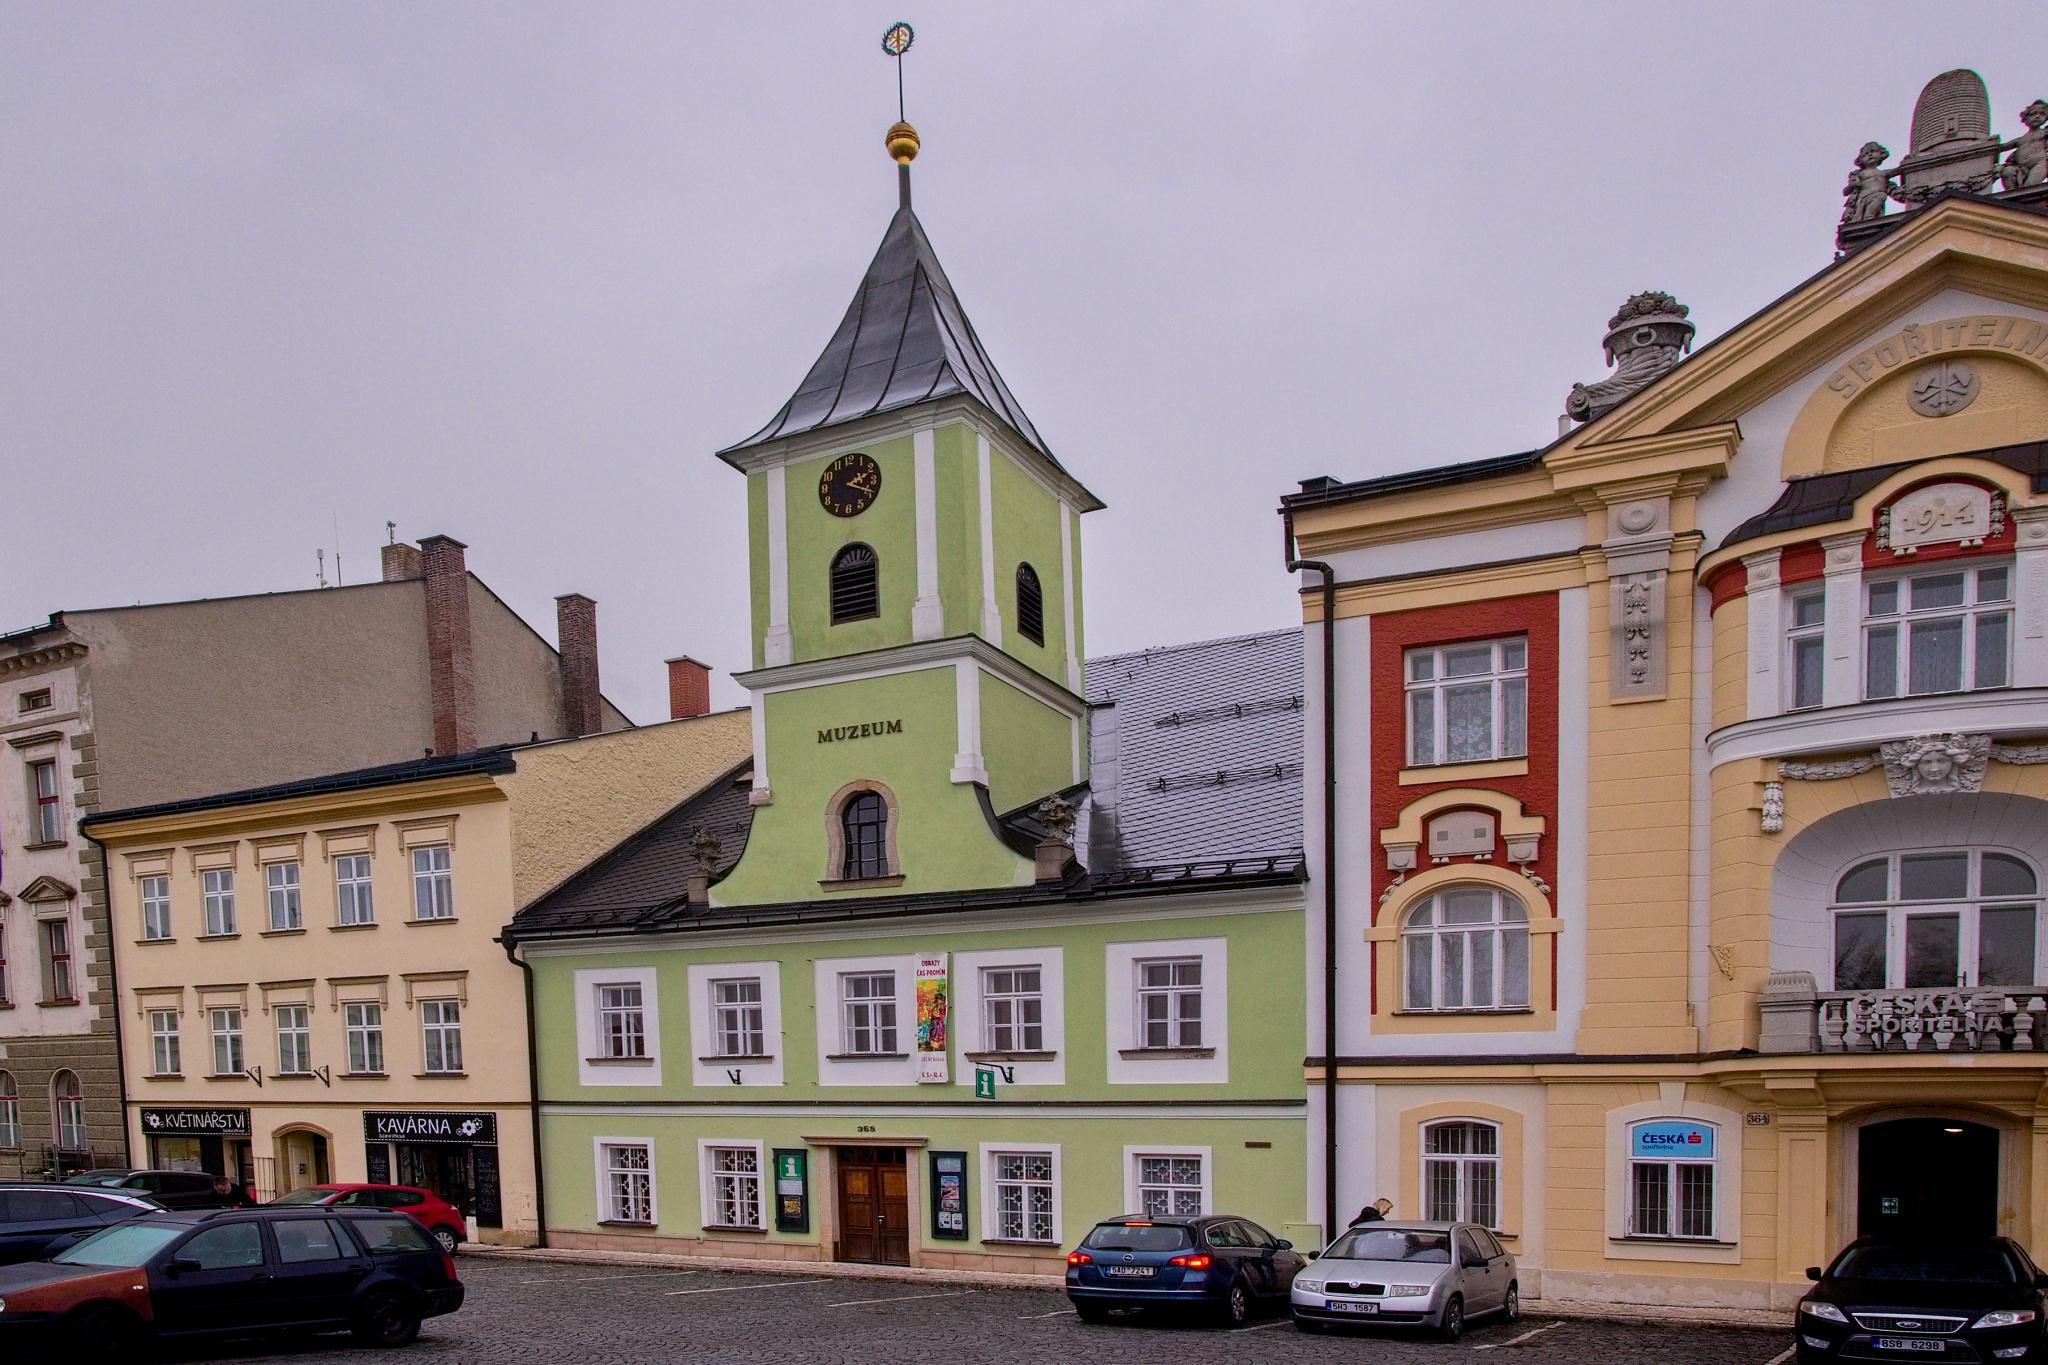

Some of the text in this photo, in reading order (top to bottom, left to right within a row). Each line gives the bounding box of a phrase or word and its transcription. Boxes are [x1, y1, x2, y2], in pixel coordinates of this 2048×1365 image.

[1828, 318, 2048, 399] SPOŘITELN
[834, 460, 841, 470] 11
[845, 455, 855, 466] 12
[859, 456, 863, 466] 1
[867, 463, 874, 473] 2
[823, 471, 833, 482] 10
[870, 474, 877, 485] 3
[821, 484, 828, 494] 9
[825, 496, 831, 505] 8
[857, 499, 864, 509] 5
[834, 503, 840, 513] 7
[845, 504, 852, 514] 6
[1903, 500, 1975, 535] 1914
[817, 719, 903, 744] MUZEUM
[1852, 991, 1967, 1015] ČESKÁ
[165, 1111, 245, 1129] KVĚTINÁŘSTVÍ
[1748, 1113, 1769, 1124] 364
[377, 1116, 452, 1135] KAVÁRNA
[857, 1125, 876, 1133] 365
[1641, 1132, 1685, 1144] ČESKÁ
[1332, 1303, 1374, 1312] 5H3 1587
[1911, 1341, 1940, 1350] 6298
